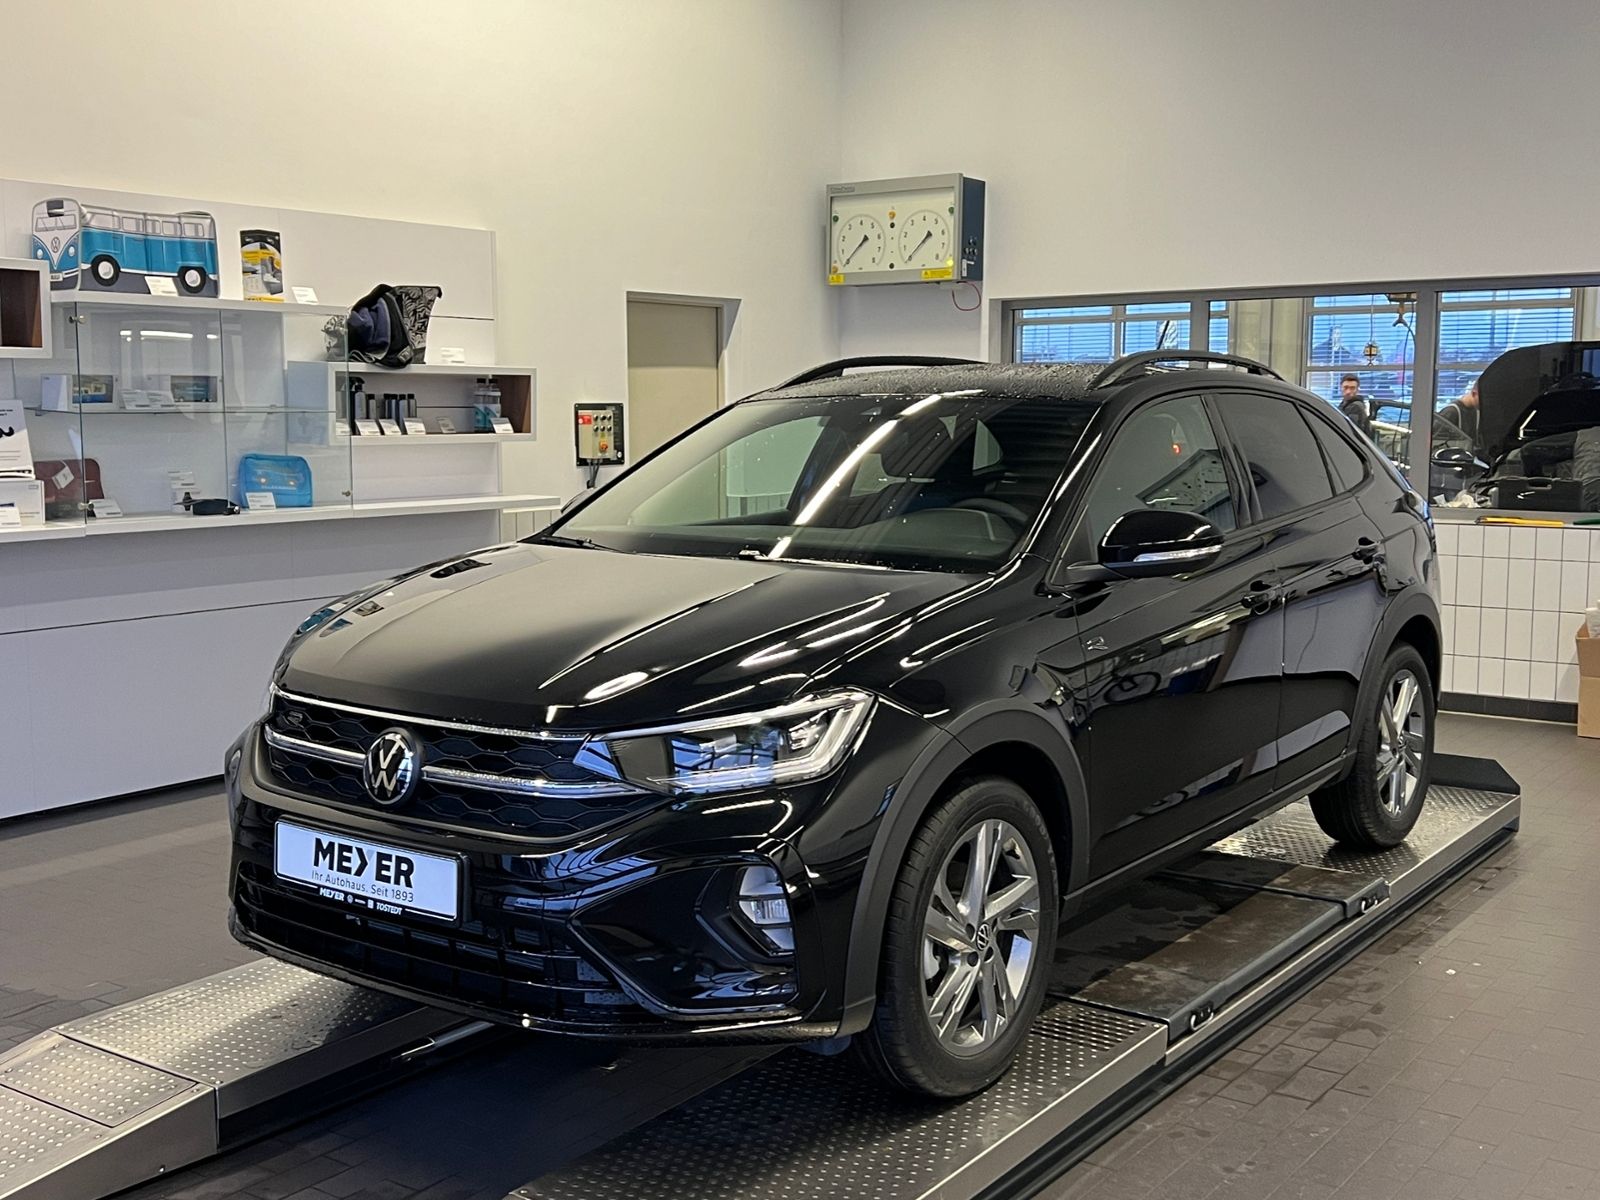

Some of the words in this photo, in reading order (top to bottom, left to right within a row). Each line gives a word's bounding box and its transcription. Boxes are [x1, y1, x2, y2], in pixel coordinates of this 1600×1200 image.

[311, 870, 323, 881] Ihr
[325, 874, 368, 893] Autohaus.
[370, 883, 389, 898] Seit
[391, 888, 414, 903] 1893
[319, 887, 345, 902] MEYER
[376, 902, 403, 915] TOSTEDT
